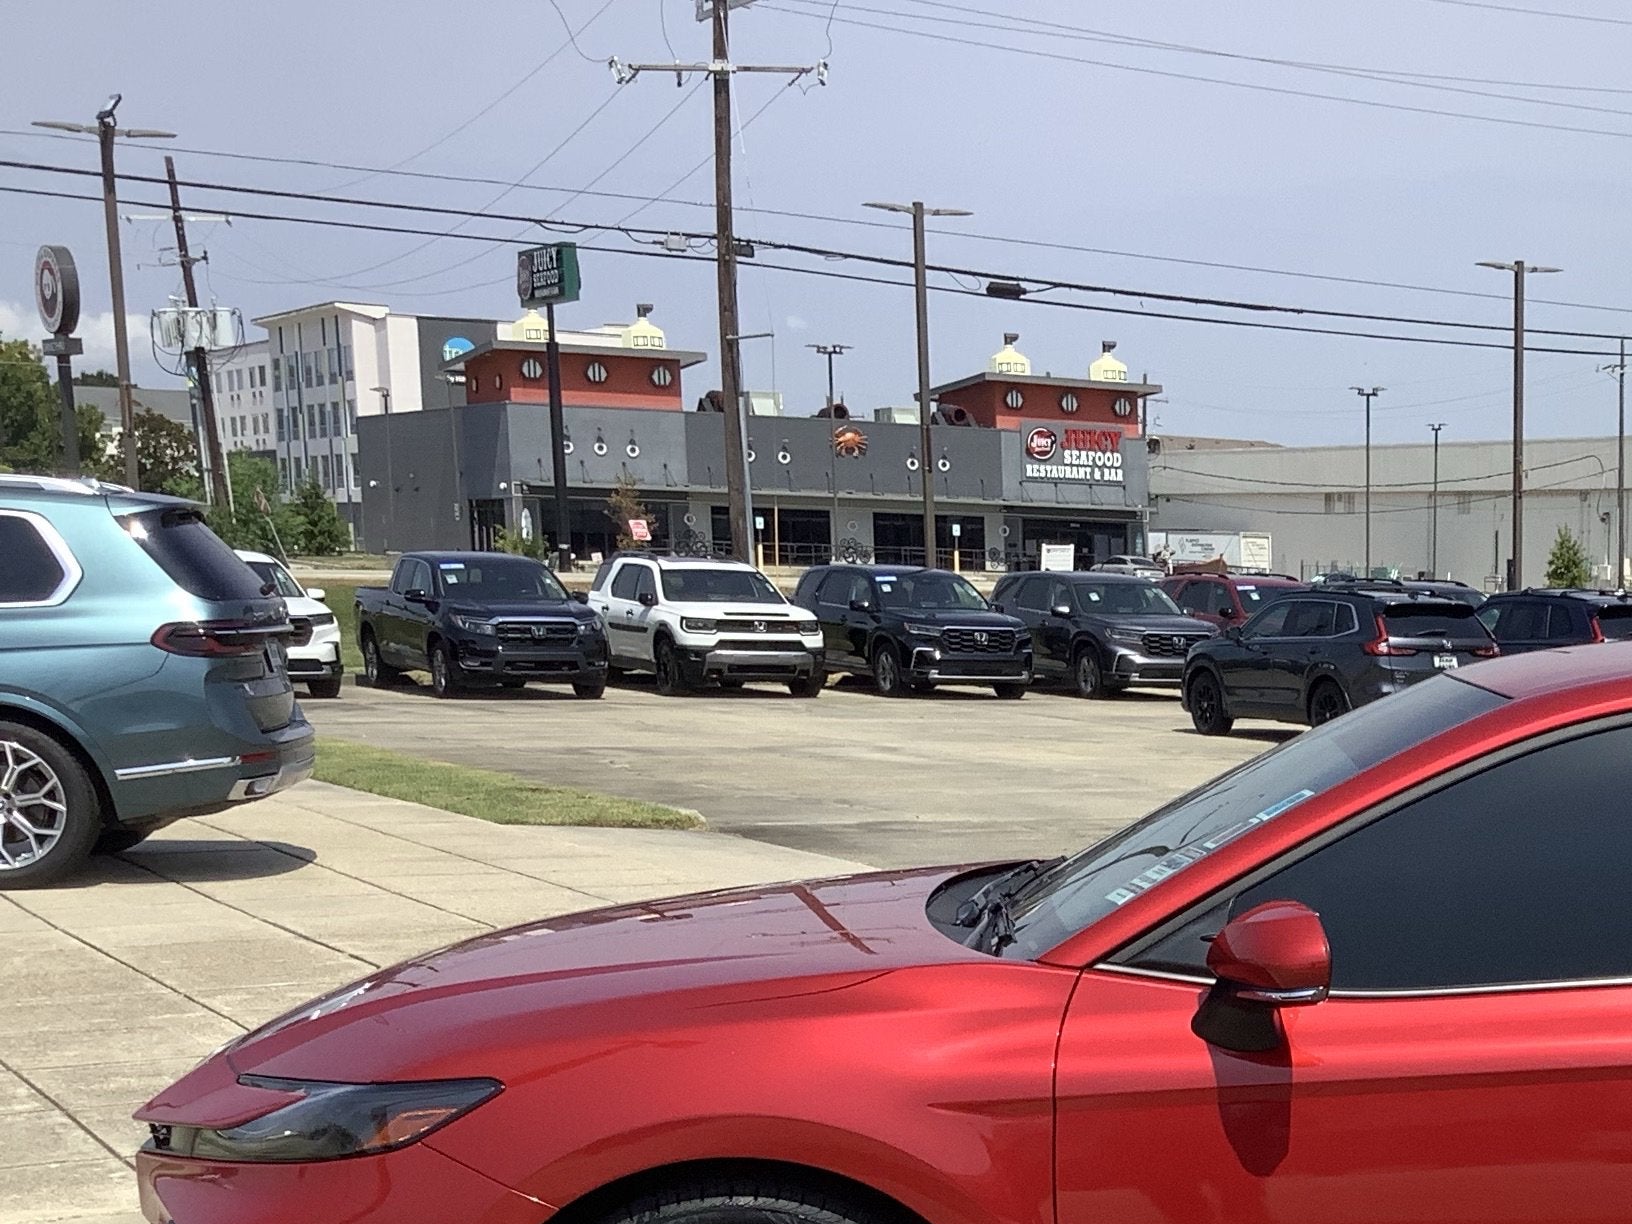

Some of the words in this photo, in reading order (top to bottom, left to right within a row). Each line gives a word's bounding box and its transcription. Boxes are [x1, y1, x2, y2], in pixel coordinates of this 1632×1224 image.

[532, 247, 558, 273] JUICY
[1061, 429, 1121, 452] JUICY
[1063, 449, 1122, 467] SEAFOOD
[1025, 463, 1092, 479] RESTAURANT
[1094, 468, 1101, 480] &
[1103, 468, 1124, 481] BAR
